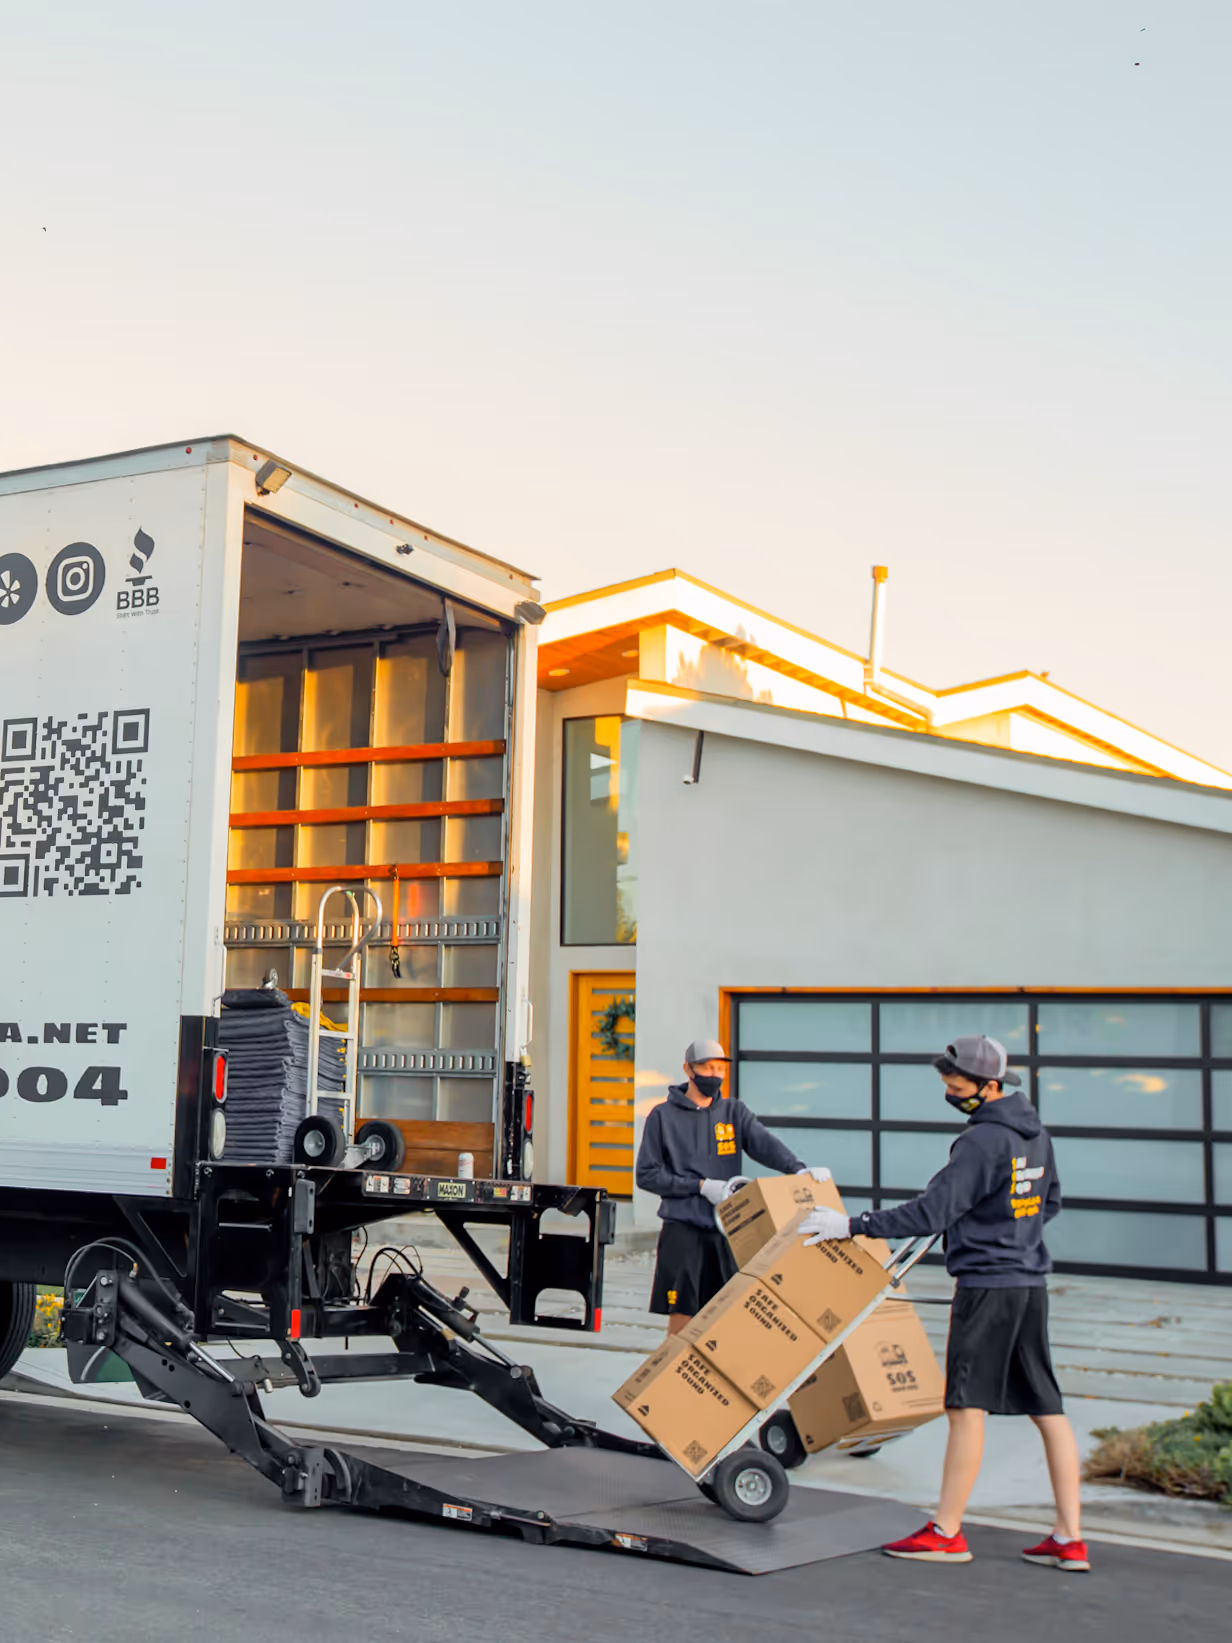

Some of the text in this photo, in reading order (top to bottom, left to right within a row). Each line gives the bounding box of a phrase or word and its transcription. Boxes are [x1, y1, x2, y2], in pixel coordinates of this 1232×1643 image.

[116, 587, 160, 610] BBB
[438, 1183, 464, 1196] MAXON
[815, 1243, 839, 1263] OUND
[756, 1289, 779, 1310] SAFE
[744, 1301, 772, 1329] SOUND
[688, 1353, 711, 1376] SAFE
[675, 1366, 705, 1395] SOUND
[680, 1360, 730, 1407] ORGANIZED
[886, 1370, 917, 1387] SOS
